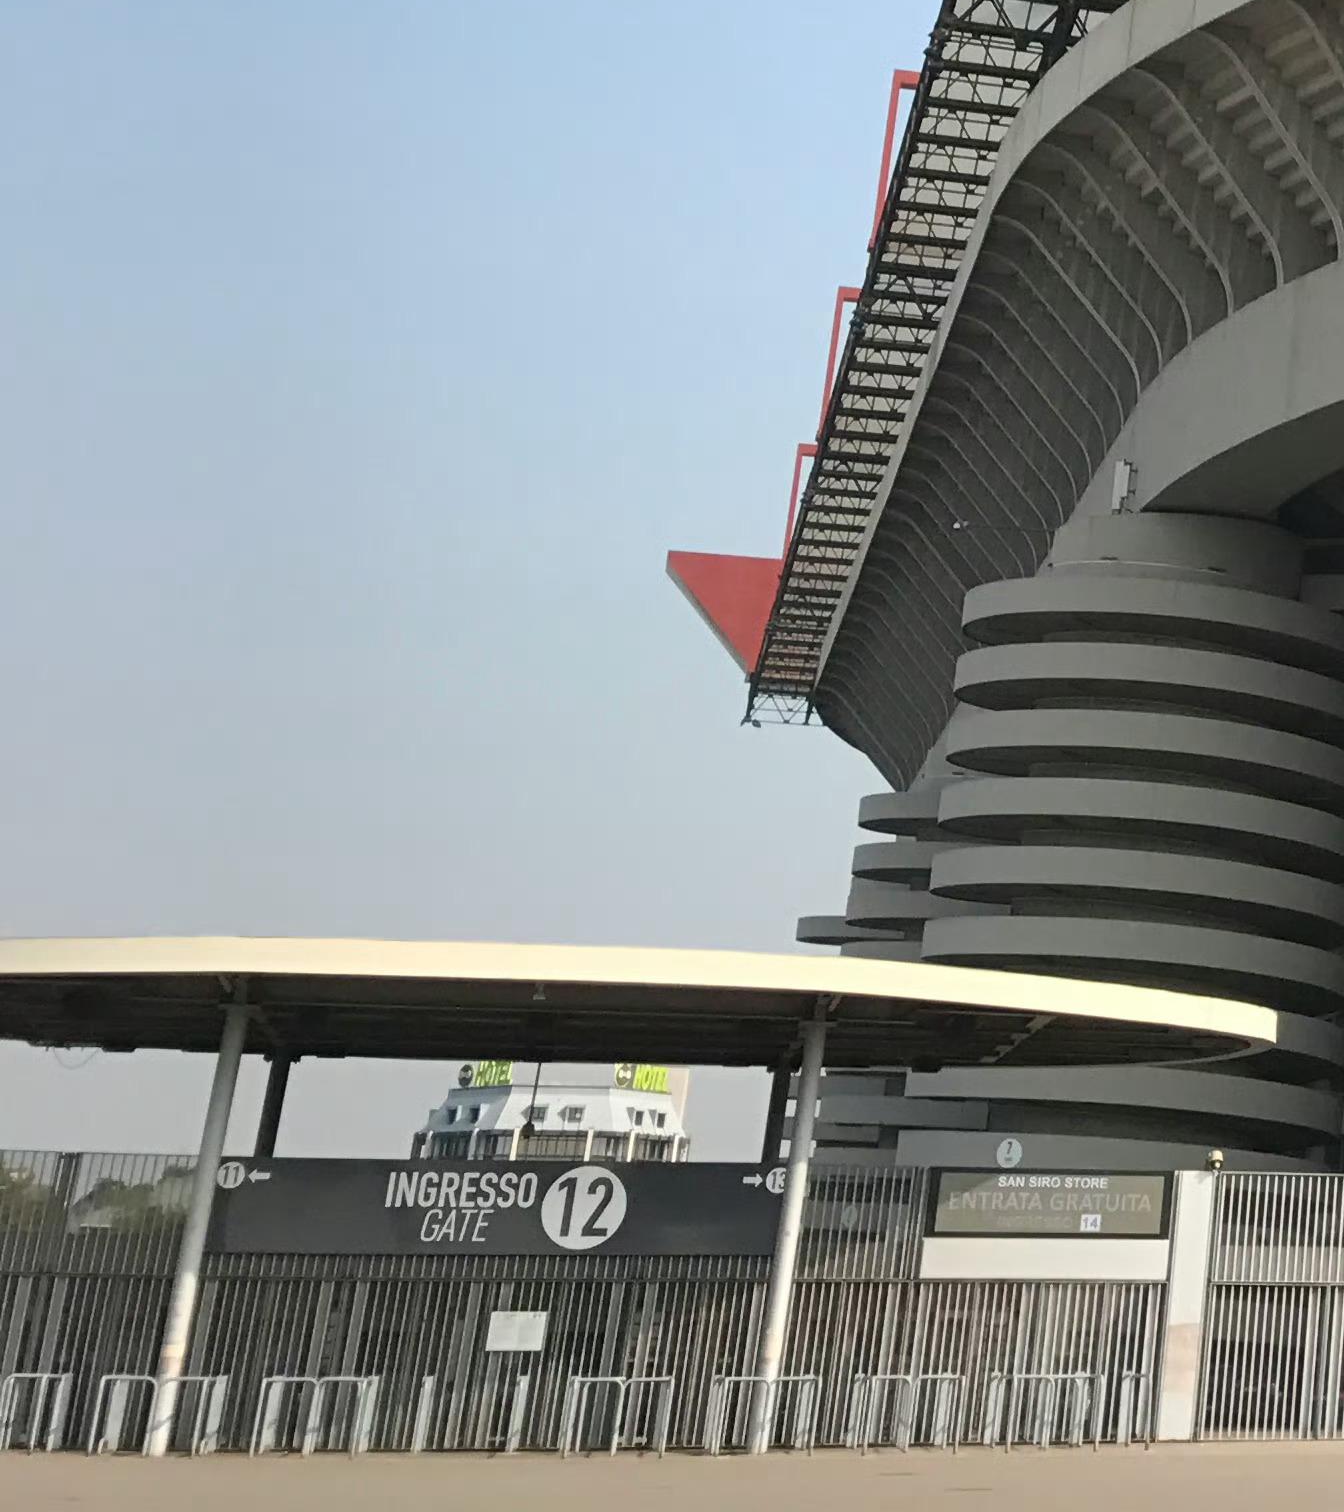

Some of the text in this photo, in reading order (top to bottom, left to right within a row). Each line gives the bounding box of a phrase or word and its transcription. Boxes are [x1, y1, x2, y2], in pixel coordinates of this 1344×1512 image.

[223, 1165, 240, 1186] 11
[998, 1175, 1110, 1190] SAN SIRO STORE
[384, 1171, 539, 1209] INGRESSO
[556, 1176, 614, 1238] 12
[948, 1191, 1152, 1212] ENTRATA GRATUITA
[420, 1209, 495, 1242] GATE
[1082, 1217, 1099, 1230] 14
